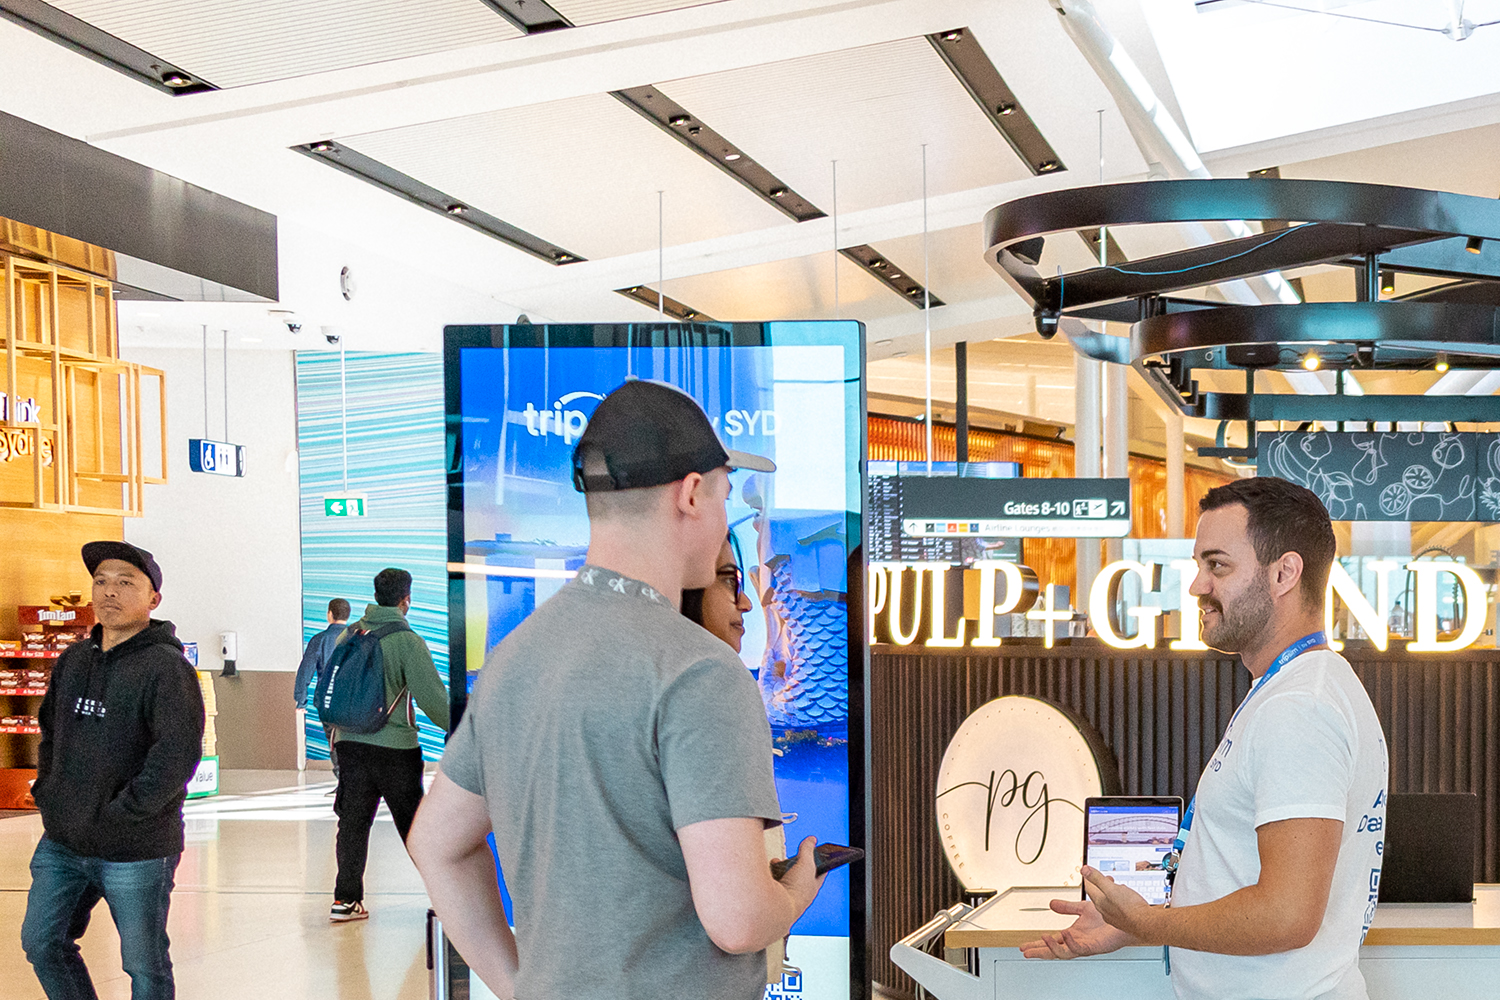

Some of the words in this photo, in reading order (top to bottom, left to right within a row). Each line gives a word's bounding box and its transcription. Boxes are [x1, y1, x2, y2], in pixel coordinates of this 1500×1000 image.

[725, 409, 782, 437] SYD
[1004, 501, 1039, 516] Gates
[1041, 501, 1070, 516] 8-10
[868, 560, 1026, 650] PULP
[942, 812, 965, 869] COFFEE
